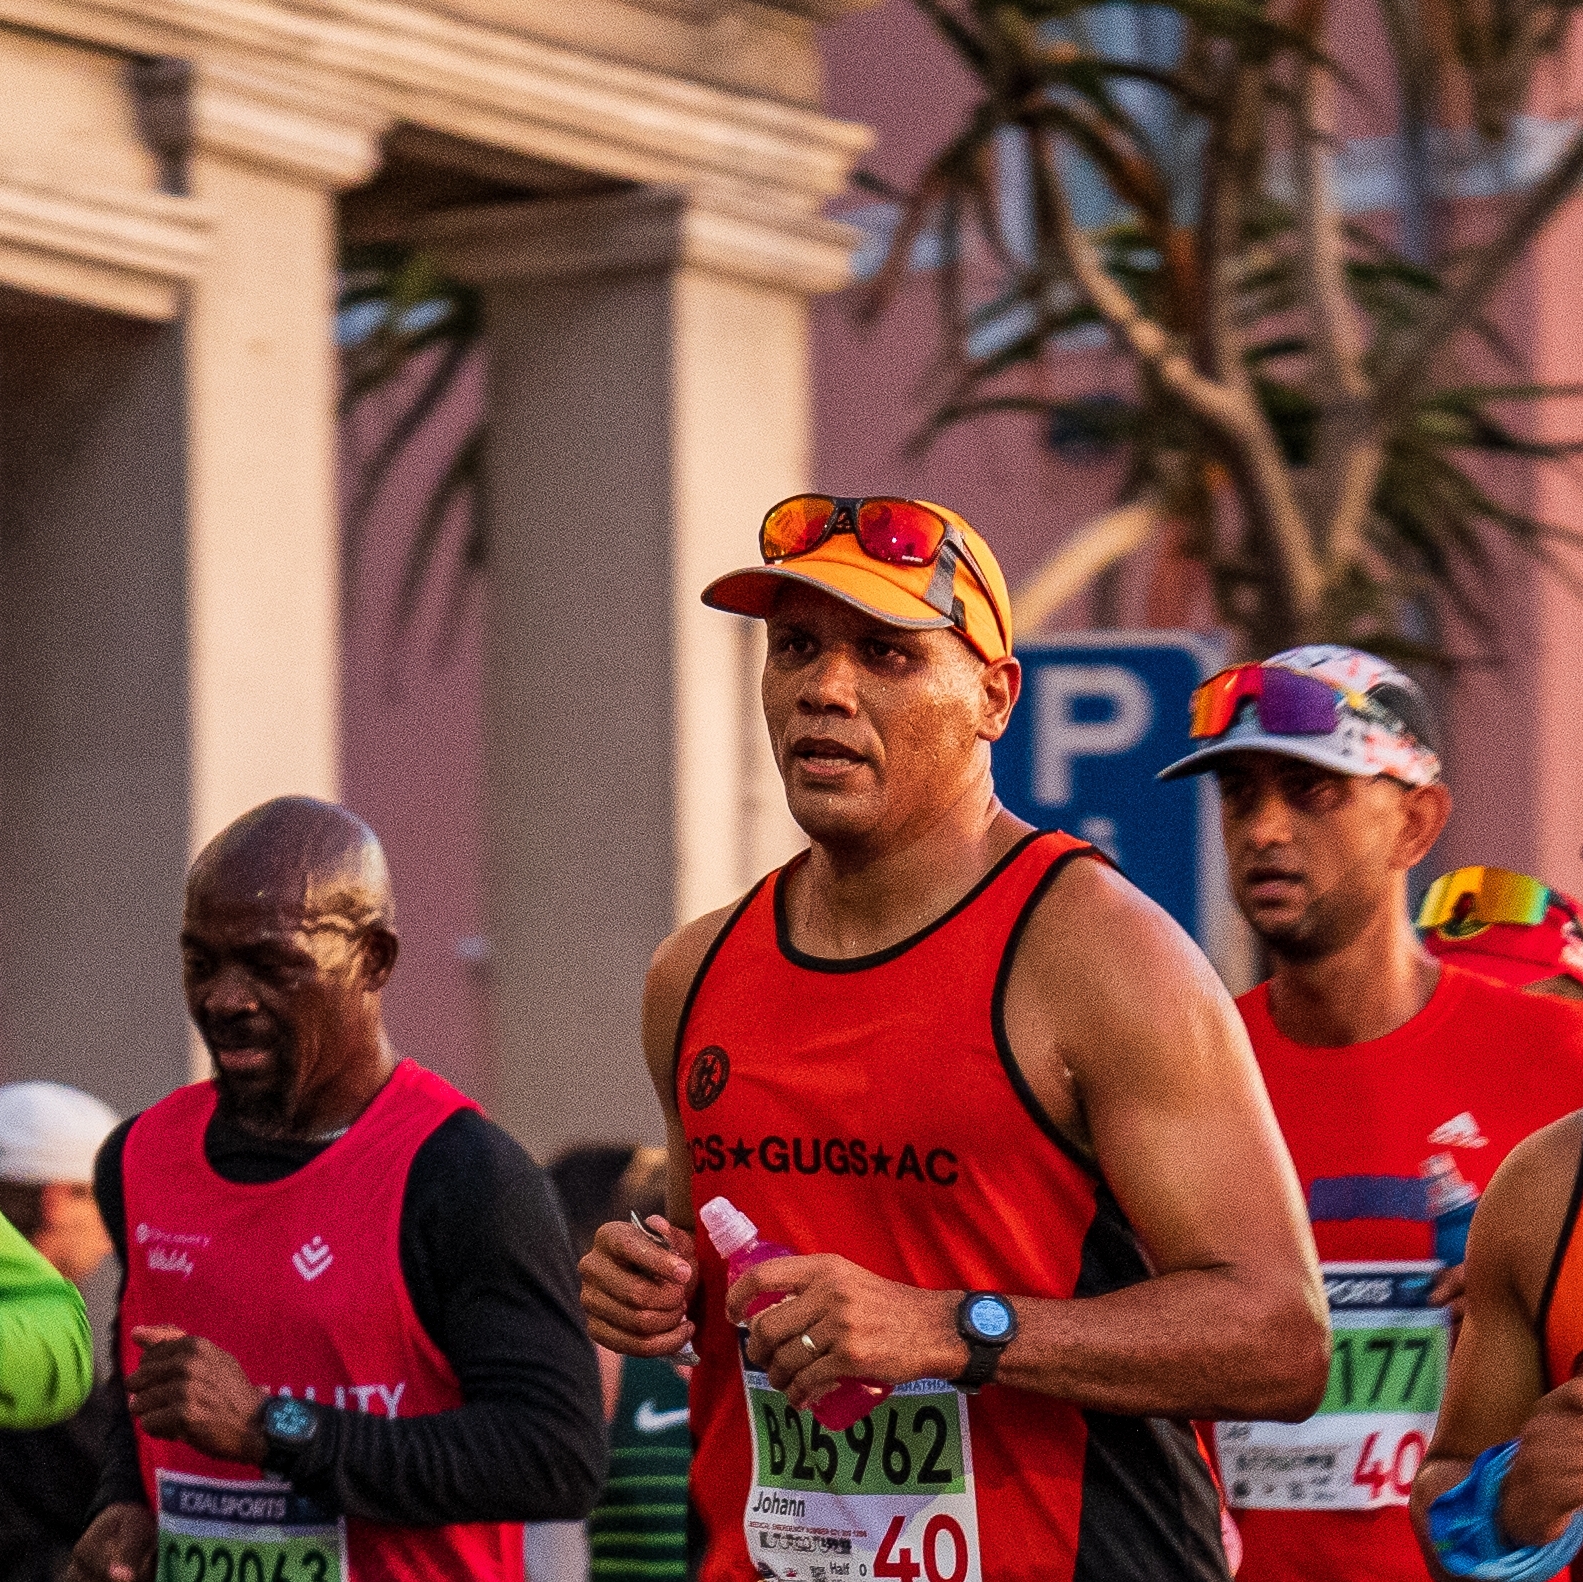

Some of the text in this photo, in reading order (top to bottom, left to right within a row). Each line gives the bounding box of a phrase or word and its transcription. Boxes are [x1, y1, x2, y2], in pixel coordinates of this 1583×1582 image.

[1032, 664, 1155, 805] P
[758, 1135, 869, 1177] GUGS
[895, 1142, 959, 1187] AC
[762, 1400, 954, 1486] B25962
[1352, 1429, 1428, 1502] 40
[752, 1491, 806, 1517] Johann
